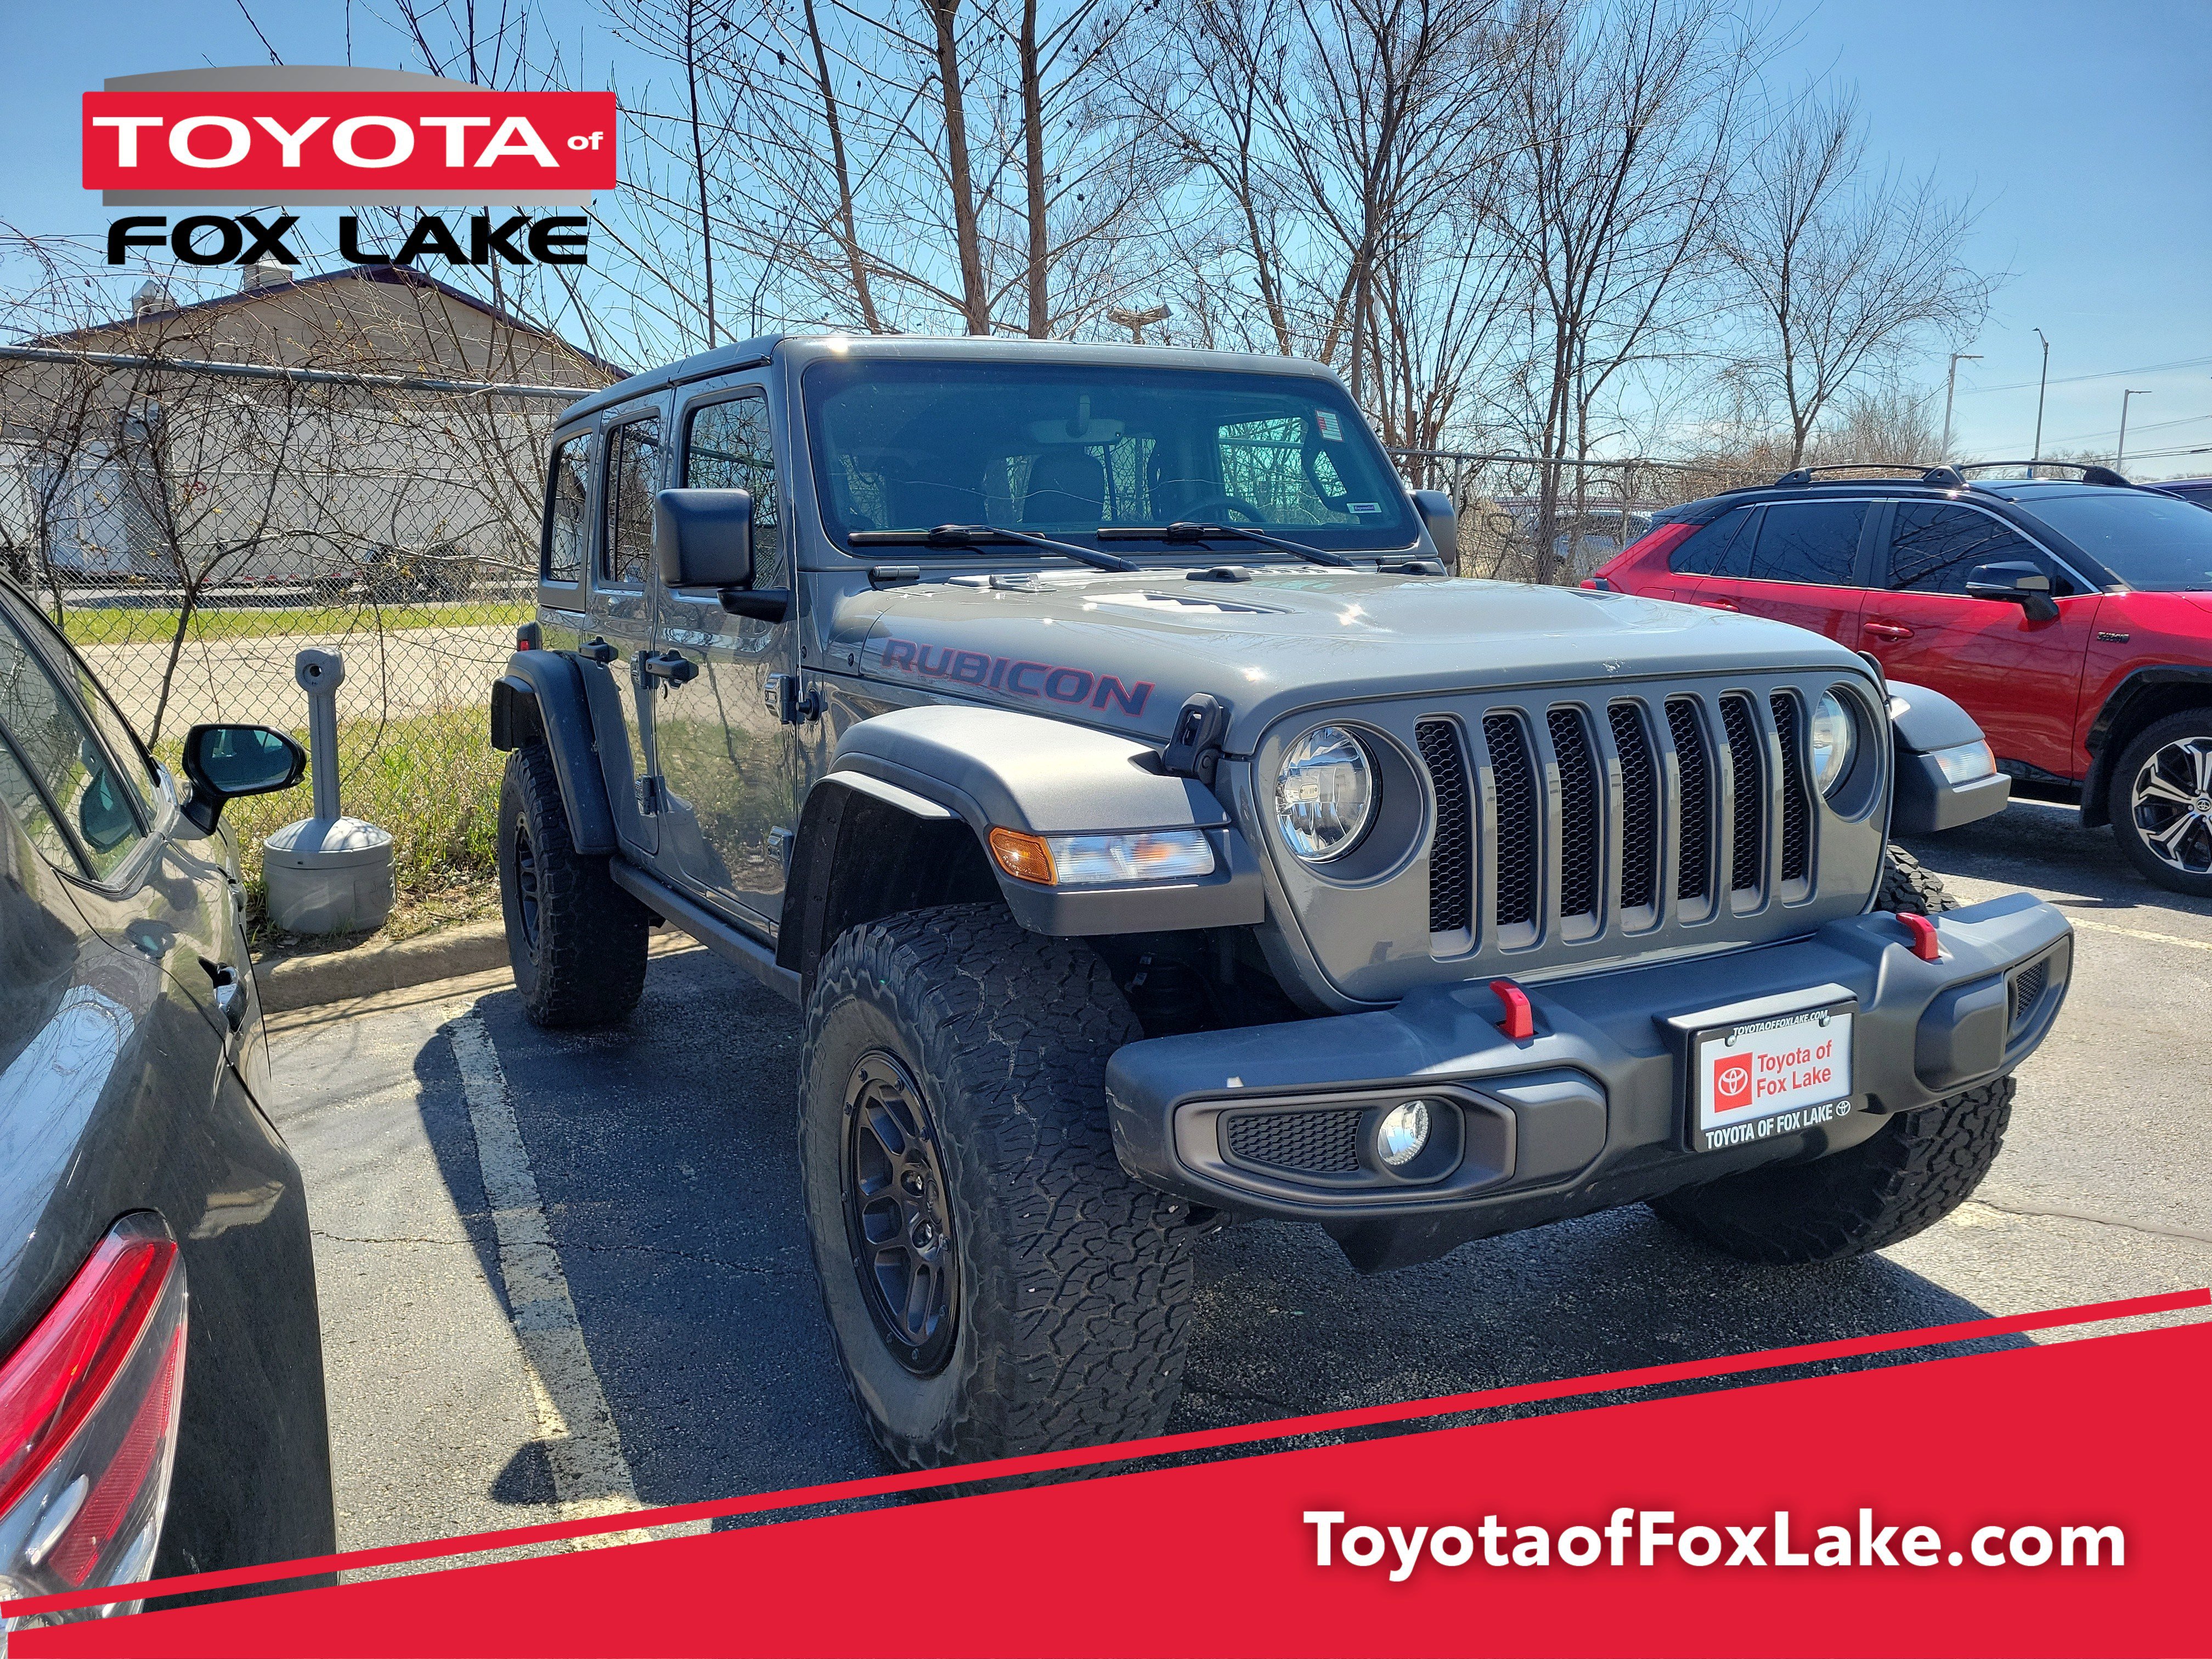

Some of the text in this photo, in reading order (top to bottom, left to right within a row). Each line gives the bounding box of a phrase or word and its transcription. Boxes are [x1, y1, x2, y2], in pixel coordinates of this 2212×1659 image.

[881, 638, 1155, 717] RUBICON
[1733, 1009, 1829, 1036] TOYOTAOFFOXLAKE.COM
[1757, 1039, 1832, 1074] Toyota of
[1757, 1066, 1831, 1098] Fox Lake
[1706, 1104, 1833, 1149] TOYOTA OF FOX LAKE
